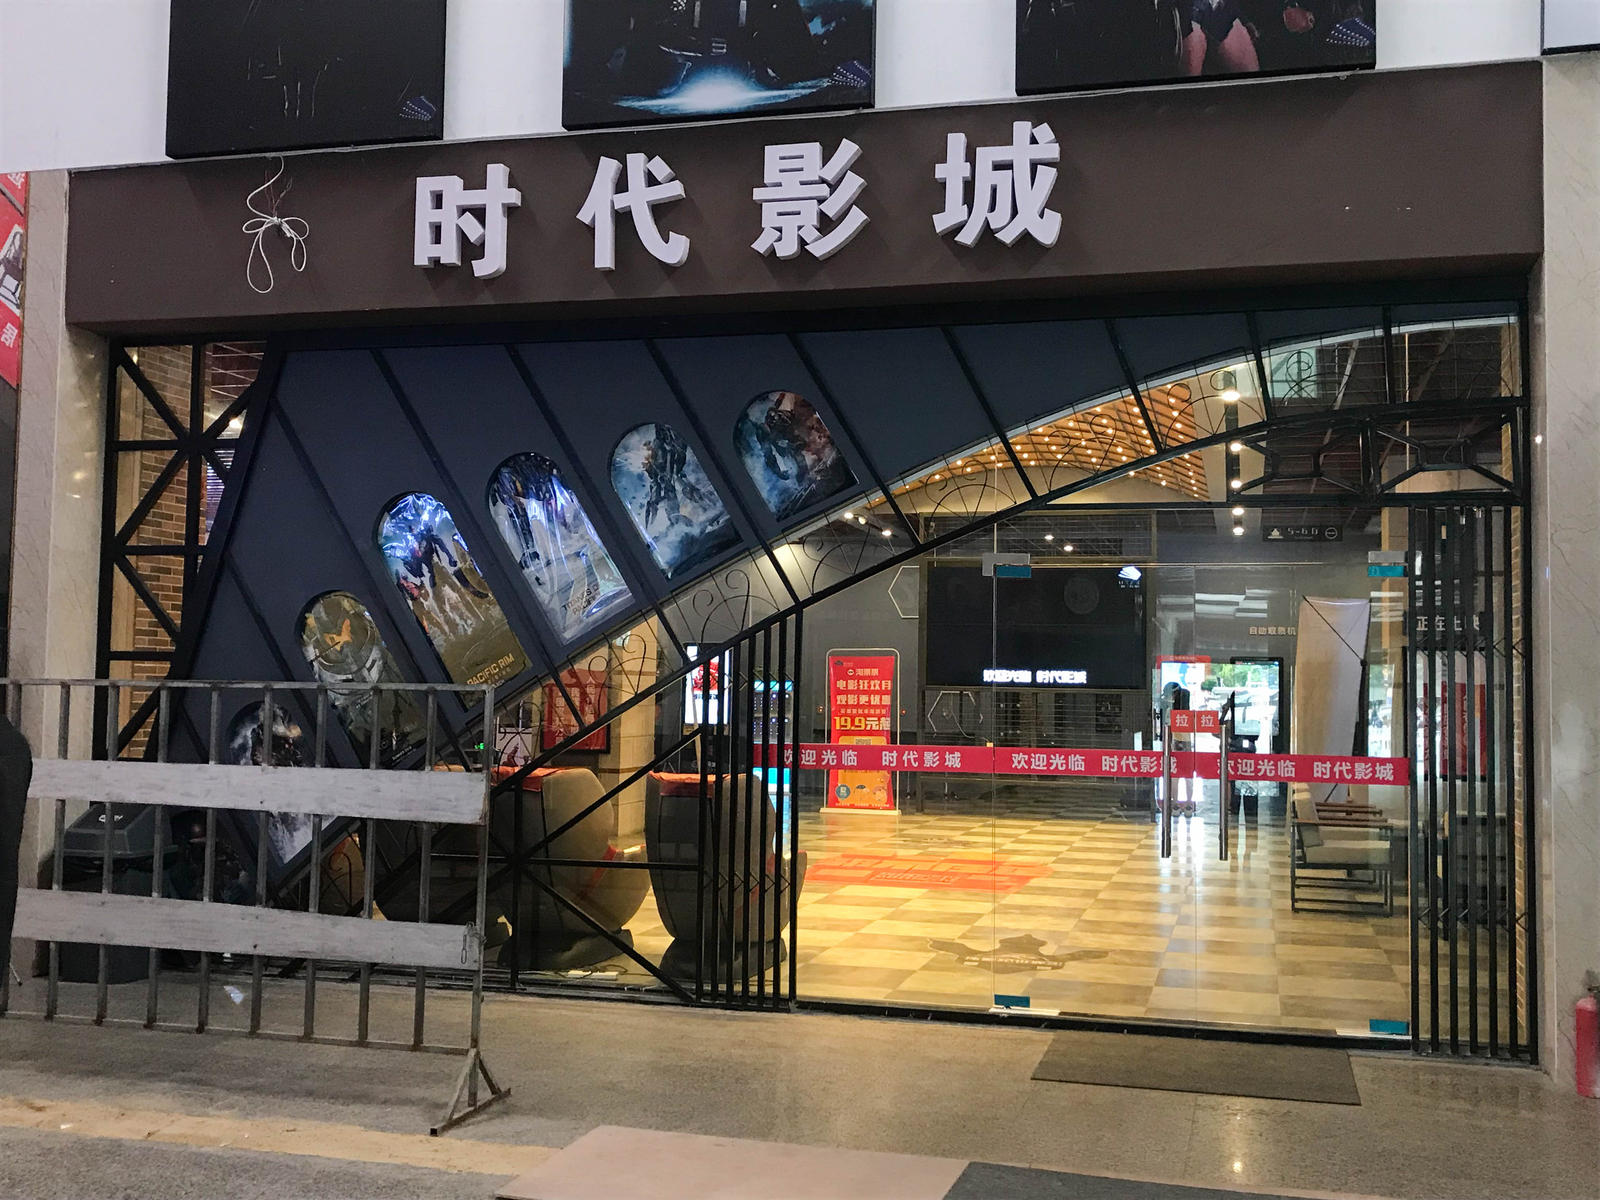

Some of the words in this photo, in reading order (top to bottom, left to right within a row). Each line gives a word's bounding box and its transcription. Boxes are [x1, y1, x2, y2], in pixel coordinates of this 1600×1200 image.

[413, 121, 1062, 279] 时代影城
[466, 663, 499, 685] PACIFIC
[498, 653, 515, 669] RIM
[1175, 713, 1189, 727] 拉
[1200, 714, 1214, 728] 拉
[882, 750, 962, 769] 时代影城
[1011, 752, 1086, 772] 欢迎光临
[1101, 754, 1178, 774] 时代影城
[1313, 761, 1395, 781] 时代影城
